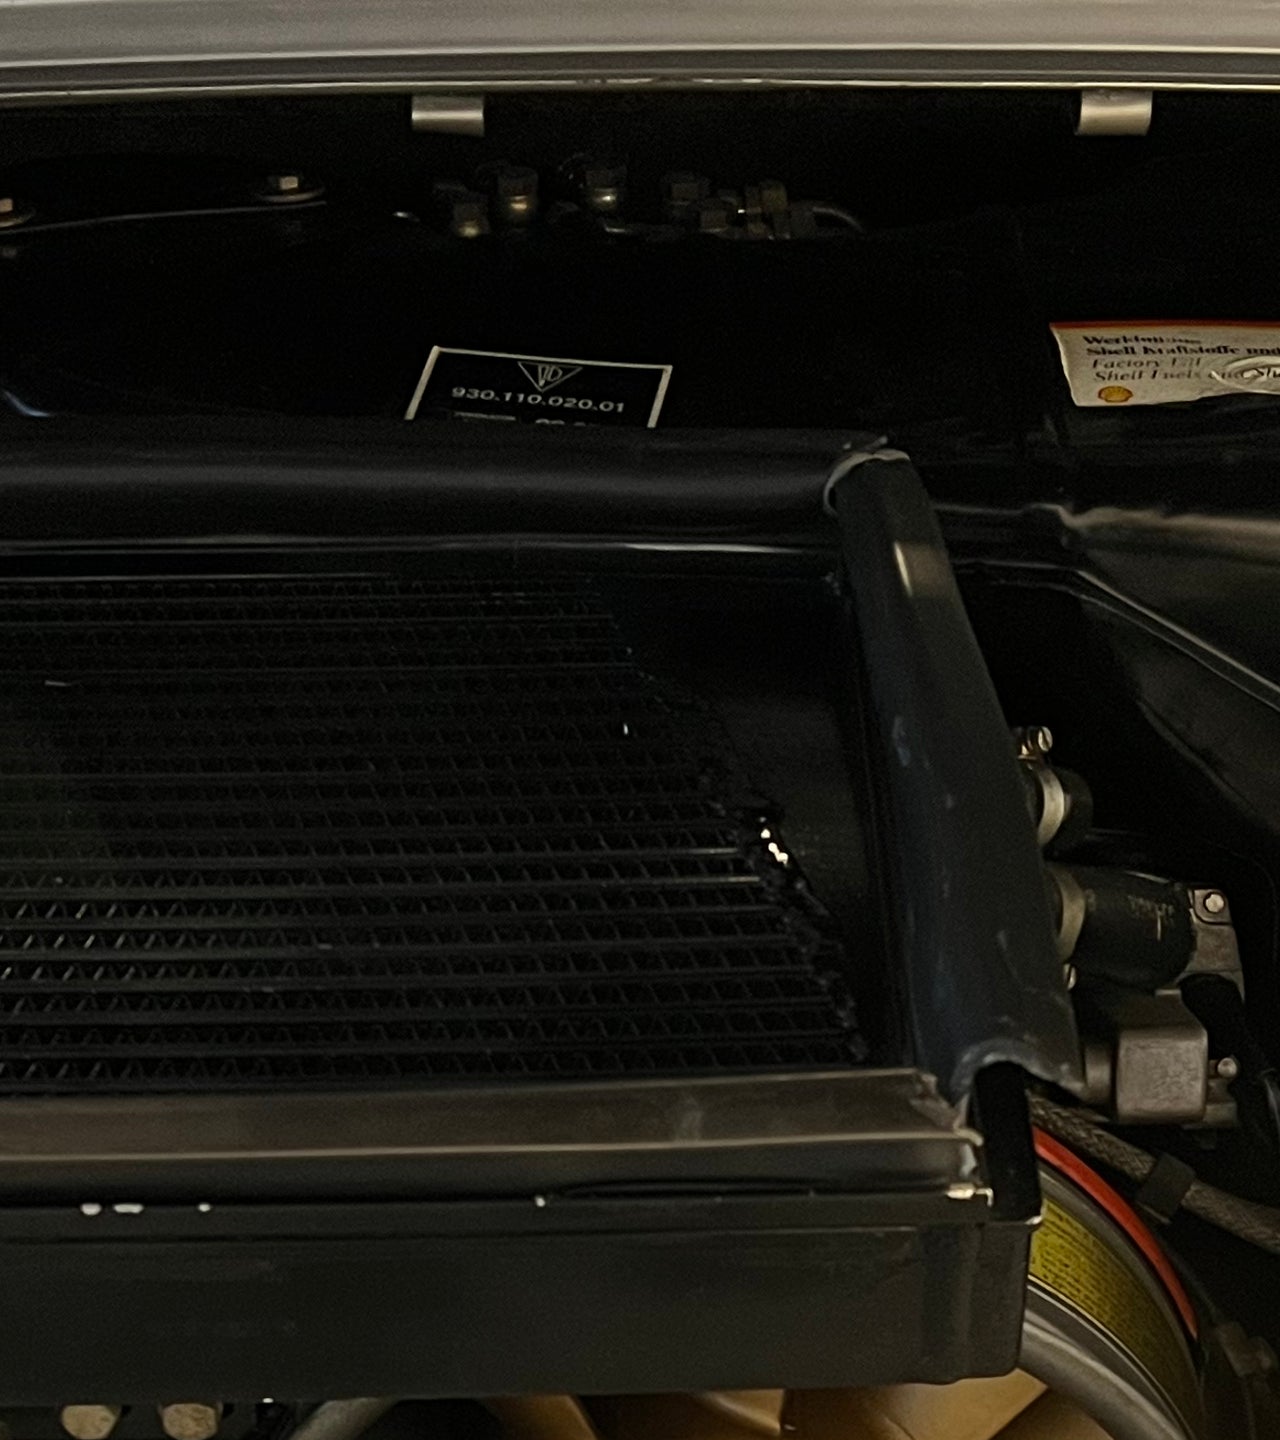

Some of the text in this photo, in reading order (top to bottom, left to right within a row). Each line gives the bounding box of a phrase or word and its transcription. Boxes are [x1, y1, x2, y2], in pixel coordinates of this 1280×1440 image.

[1086, 346, 1136, 355] Shell
[1092, 359, 1160, 369] Factory
[1094, 370, 1144, 381] Shell
[451, 386, 624, 413] 930.110.020.01
